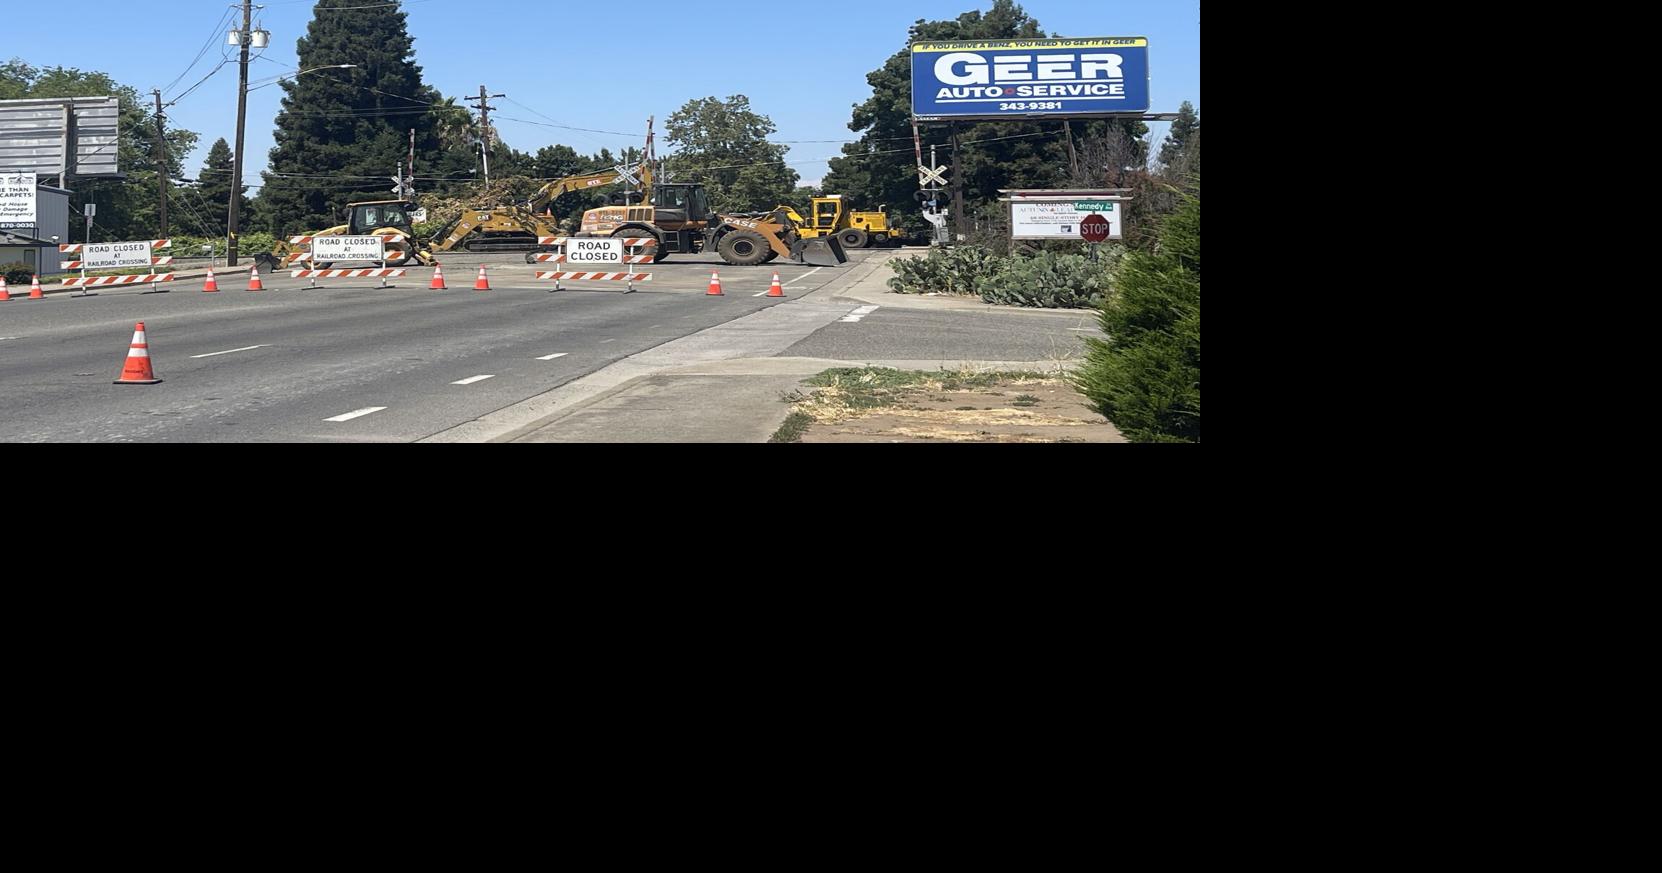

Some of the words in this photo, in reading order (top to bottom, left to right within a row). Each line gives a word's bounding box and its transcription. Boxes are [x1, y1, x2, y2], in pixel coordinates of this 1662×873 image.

[934, 52, 1123, 85] GEER
[936, 86, 1003, 98] AUTO
[1016, 83, 1125, 97] SERVICE
[1000, 101, 1062, 110] 343-9381
[1074, 202, 1104, 211] Kennedy
[724, 217, 757, 228] CASE
[1082, 223, 1108, 234] STOP
[113, 244, 144, 252] CLOSED
[578, 241, 611, 250] ROAD
[571, 252, 618, 261] CLOSED
